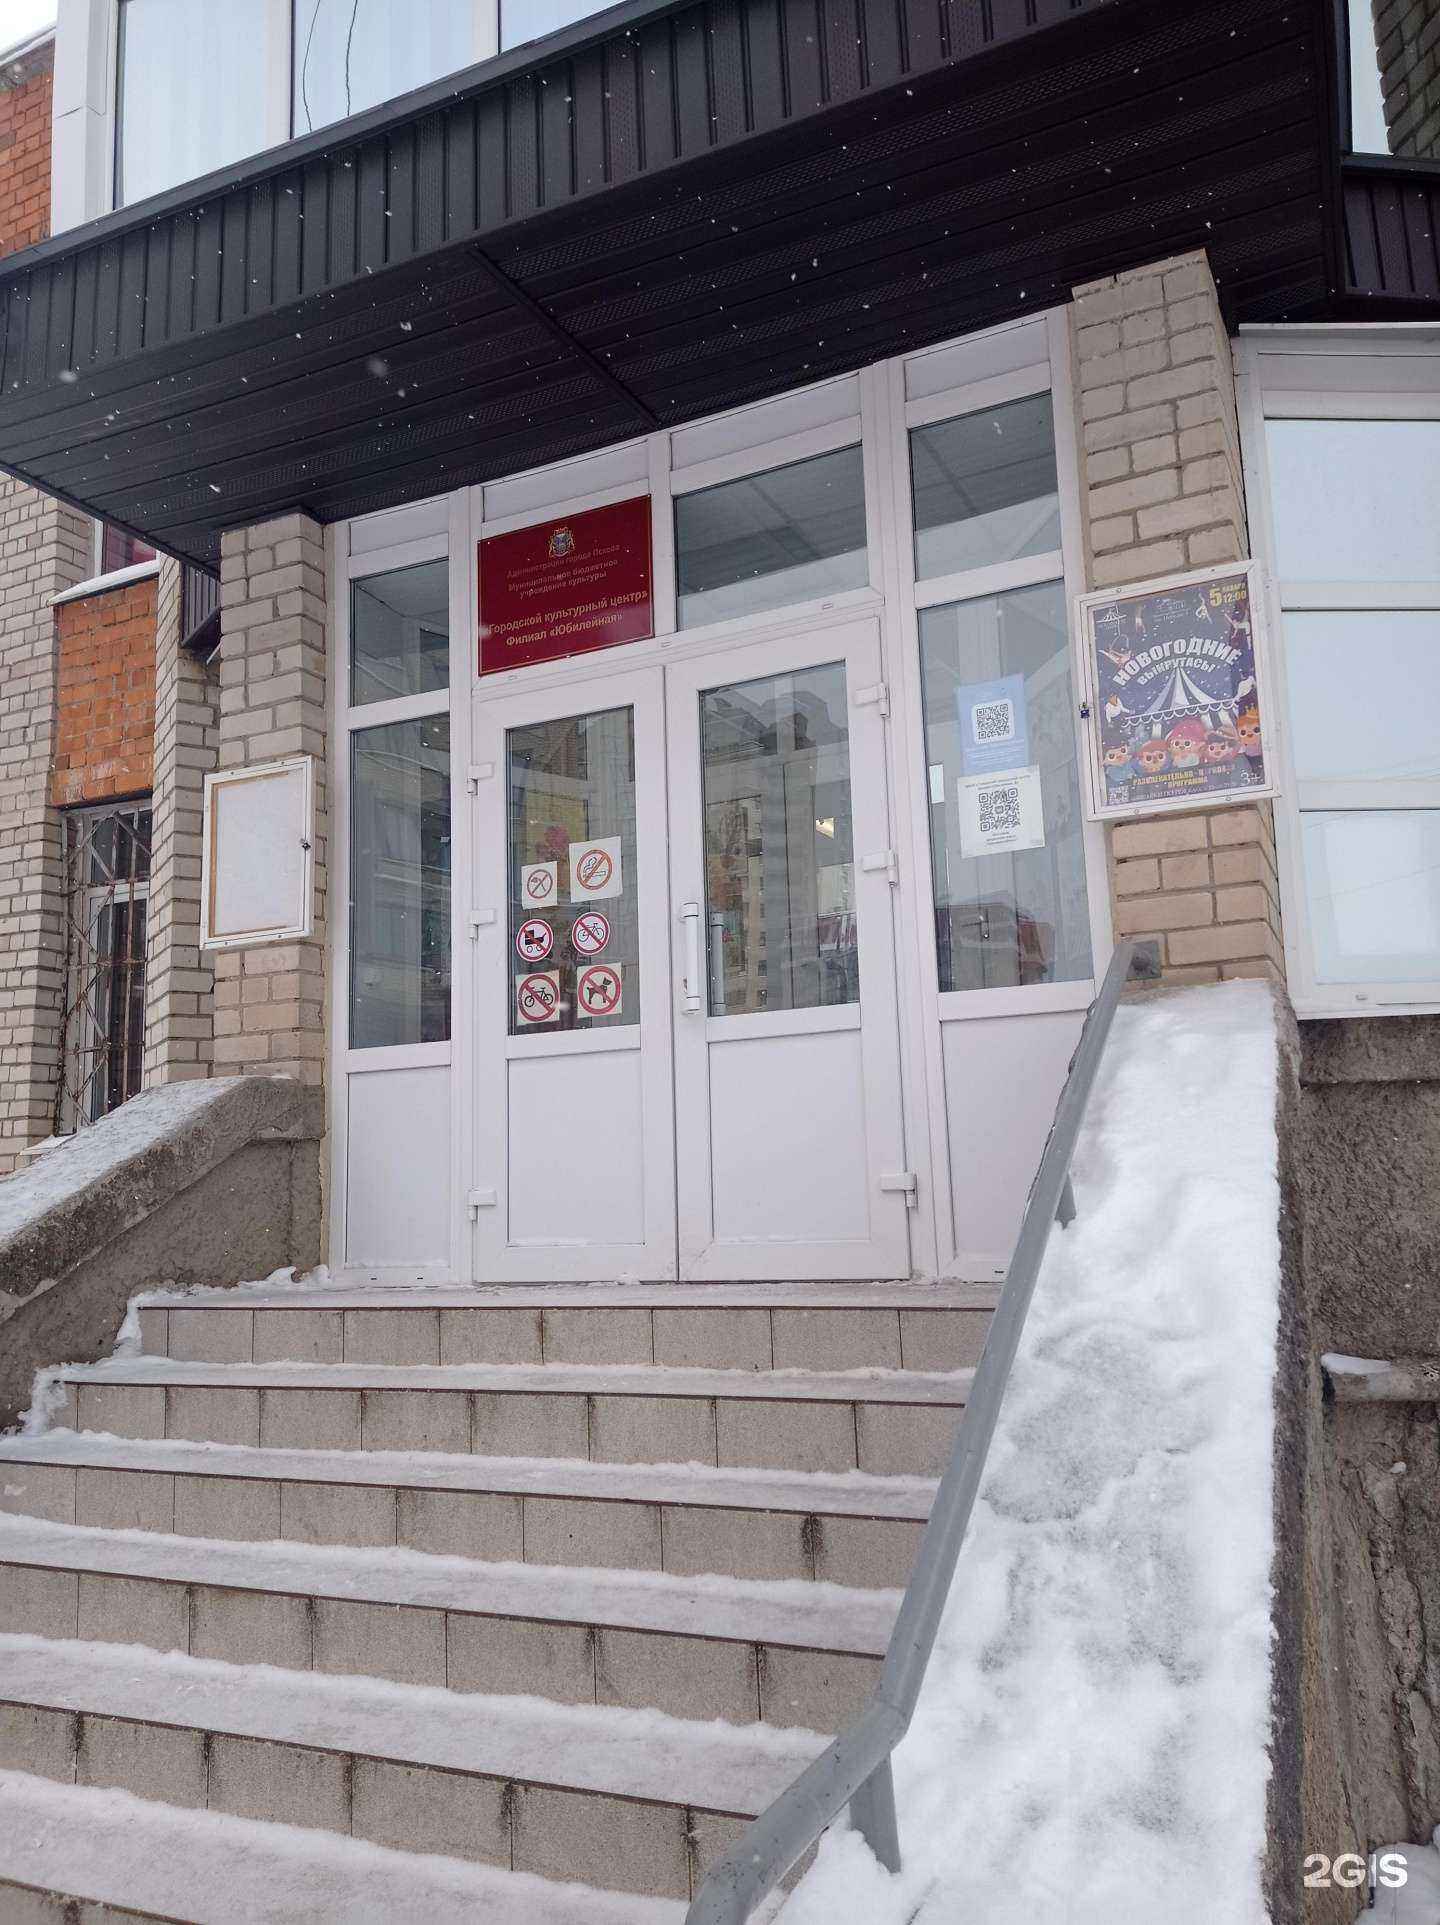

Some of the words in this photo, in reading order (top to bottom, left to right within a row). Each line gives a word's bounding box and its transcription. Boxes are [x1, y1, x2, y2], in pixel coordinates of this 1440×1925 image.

[508, 571, 571, 592] Муниципальное
[568, 570, 607, 588] культуры
[1209, 588, 1222, 606] 5
[1222, 590, 1246, 603] 12:00
[484, 613, 542, 635] Городской
[544, 596, 607, 623] культурный
[610, 589, 648, 607] центр»
[506, 631, 547, 646] Филиал
[550, 612, 622, 637] «Юбилейная»
[1112, 636, 1242, 686] НОВОГОДНИЕ
[1136, 657, 1216, 686] ВЫКРУТАСЫ
